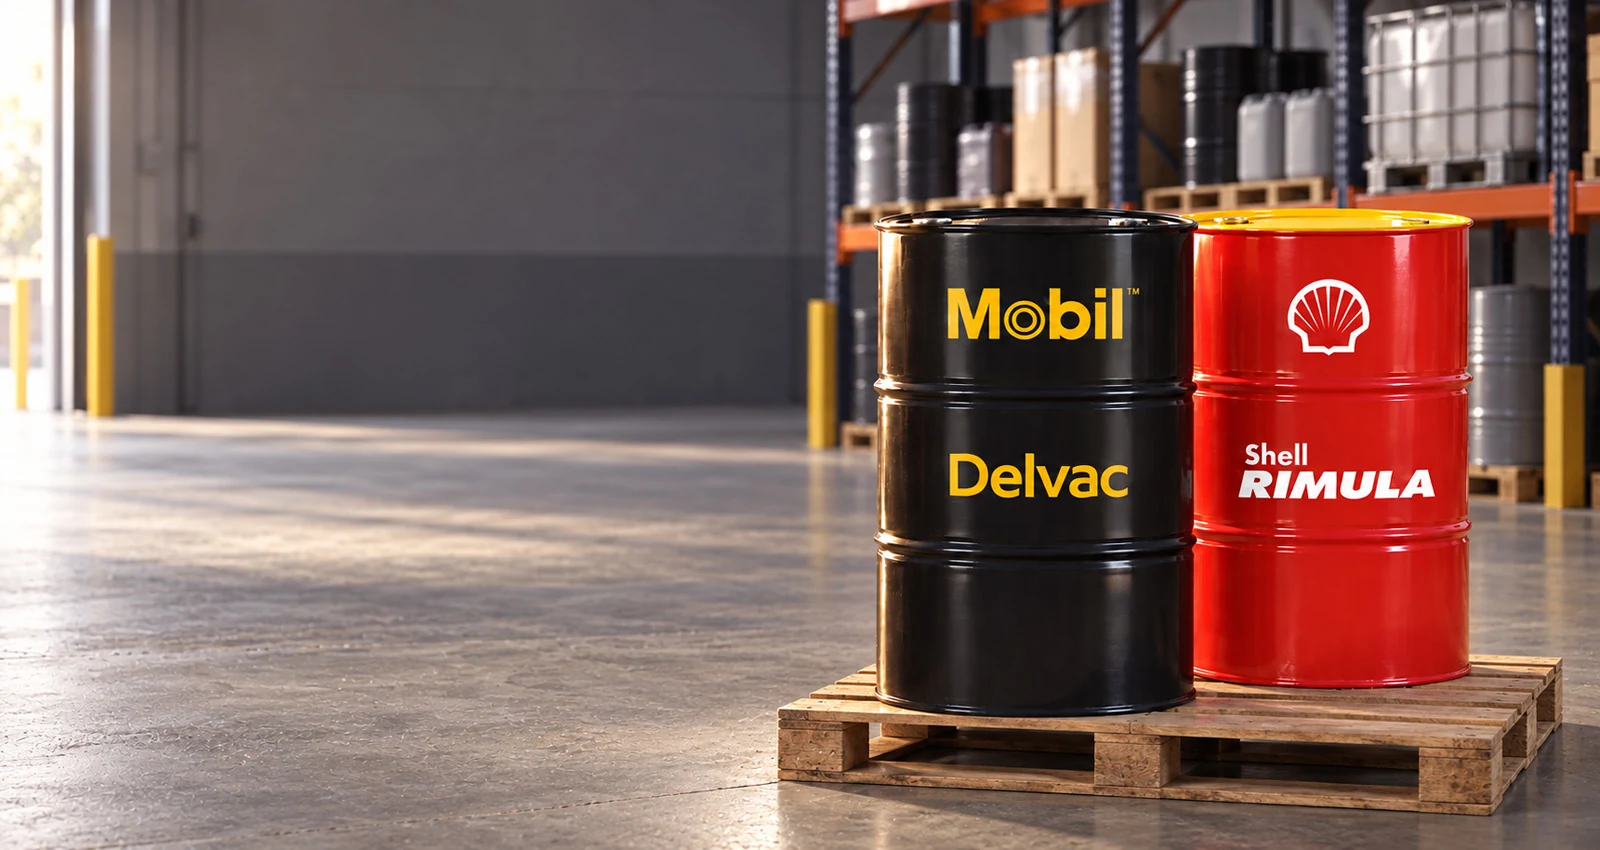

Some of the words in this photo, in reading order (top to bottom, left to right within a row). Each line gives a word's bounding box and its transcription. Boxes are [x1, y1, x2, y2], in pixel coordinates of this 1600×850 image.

[947, 288, 1123, 340] Mobil
[1245, 443, 1308, 466] Shell
[949, 453, 1129, 498] Delvac
[1238, 470, 1435, 500] RIMULA
